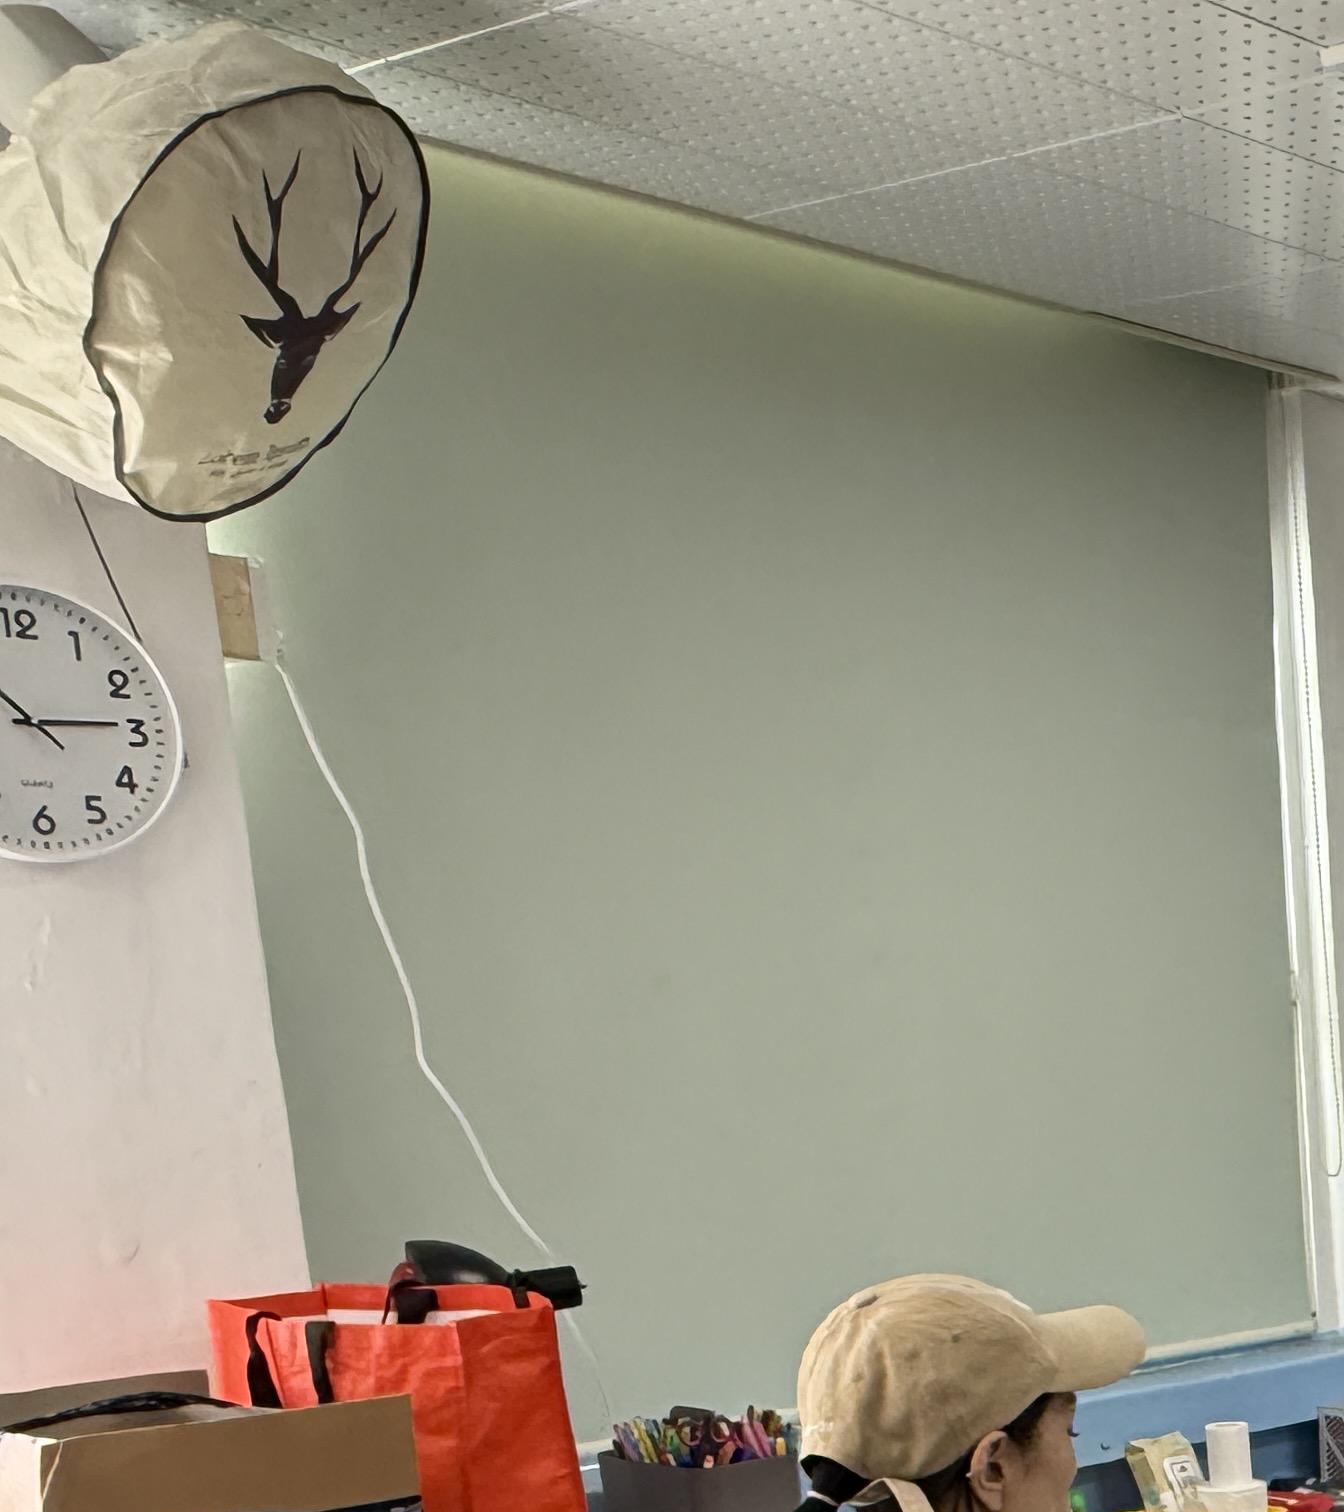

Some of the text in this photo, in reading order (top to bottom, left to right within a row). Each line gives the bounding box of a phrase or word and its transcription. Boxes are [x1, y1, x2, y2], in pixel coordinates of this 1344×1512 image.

[0, 607, 38, 640] 12
[67, 630, 82, 661] 1
[107, 669, 132, 699] 2
[126, 718, 149, 747] 3
[115, 765, 138, 794] 4
[32, 804, 56, 835] 6
[84, 795, 107, 825] 5
